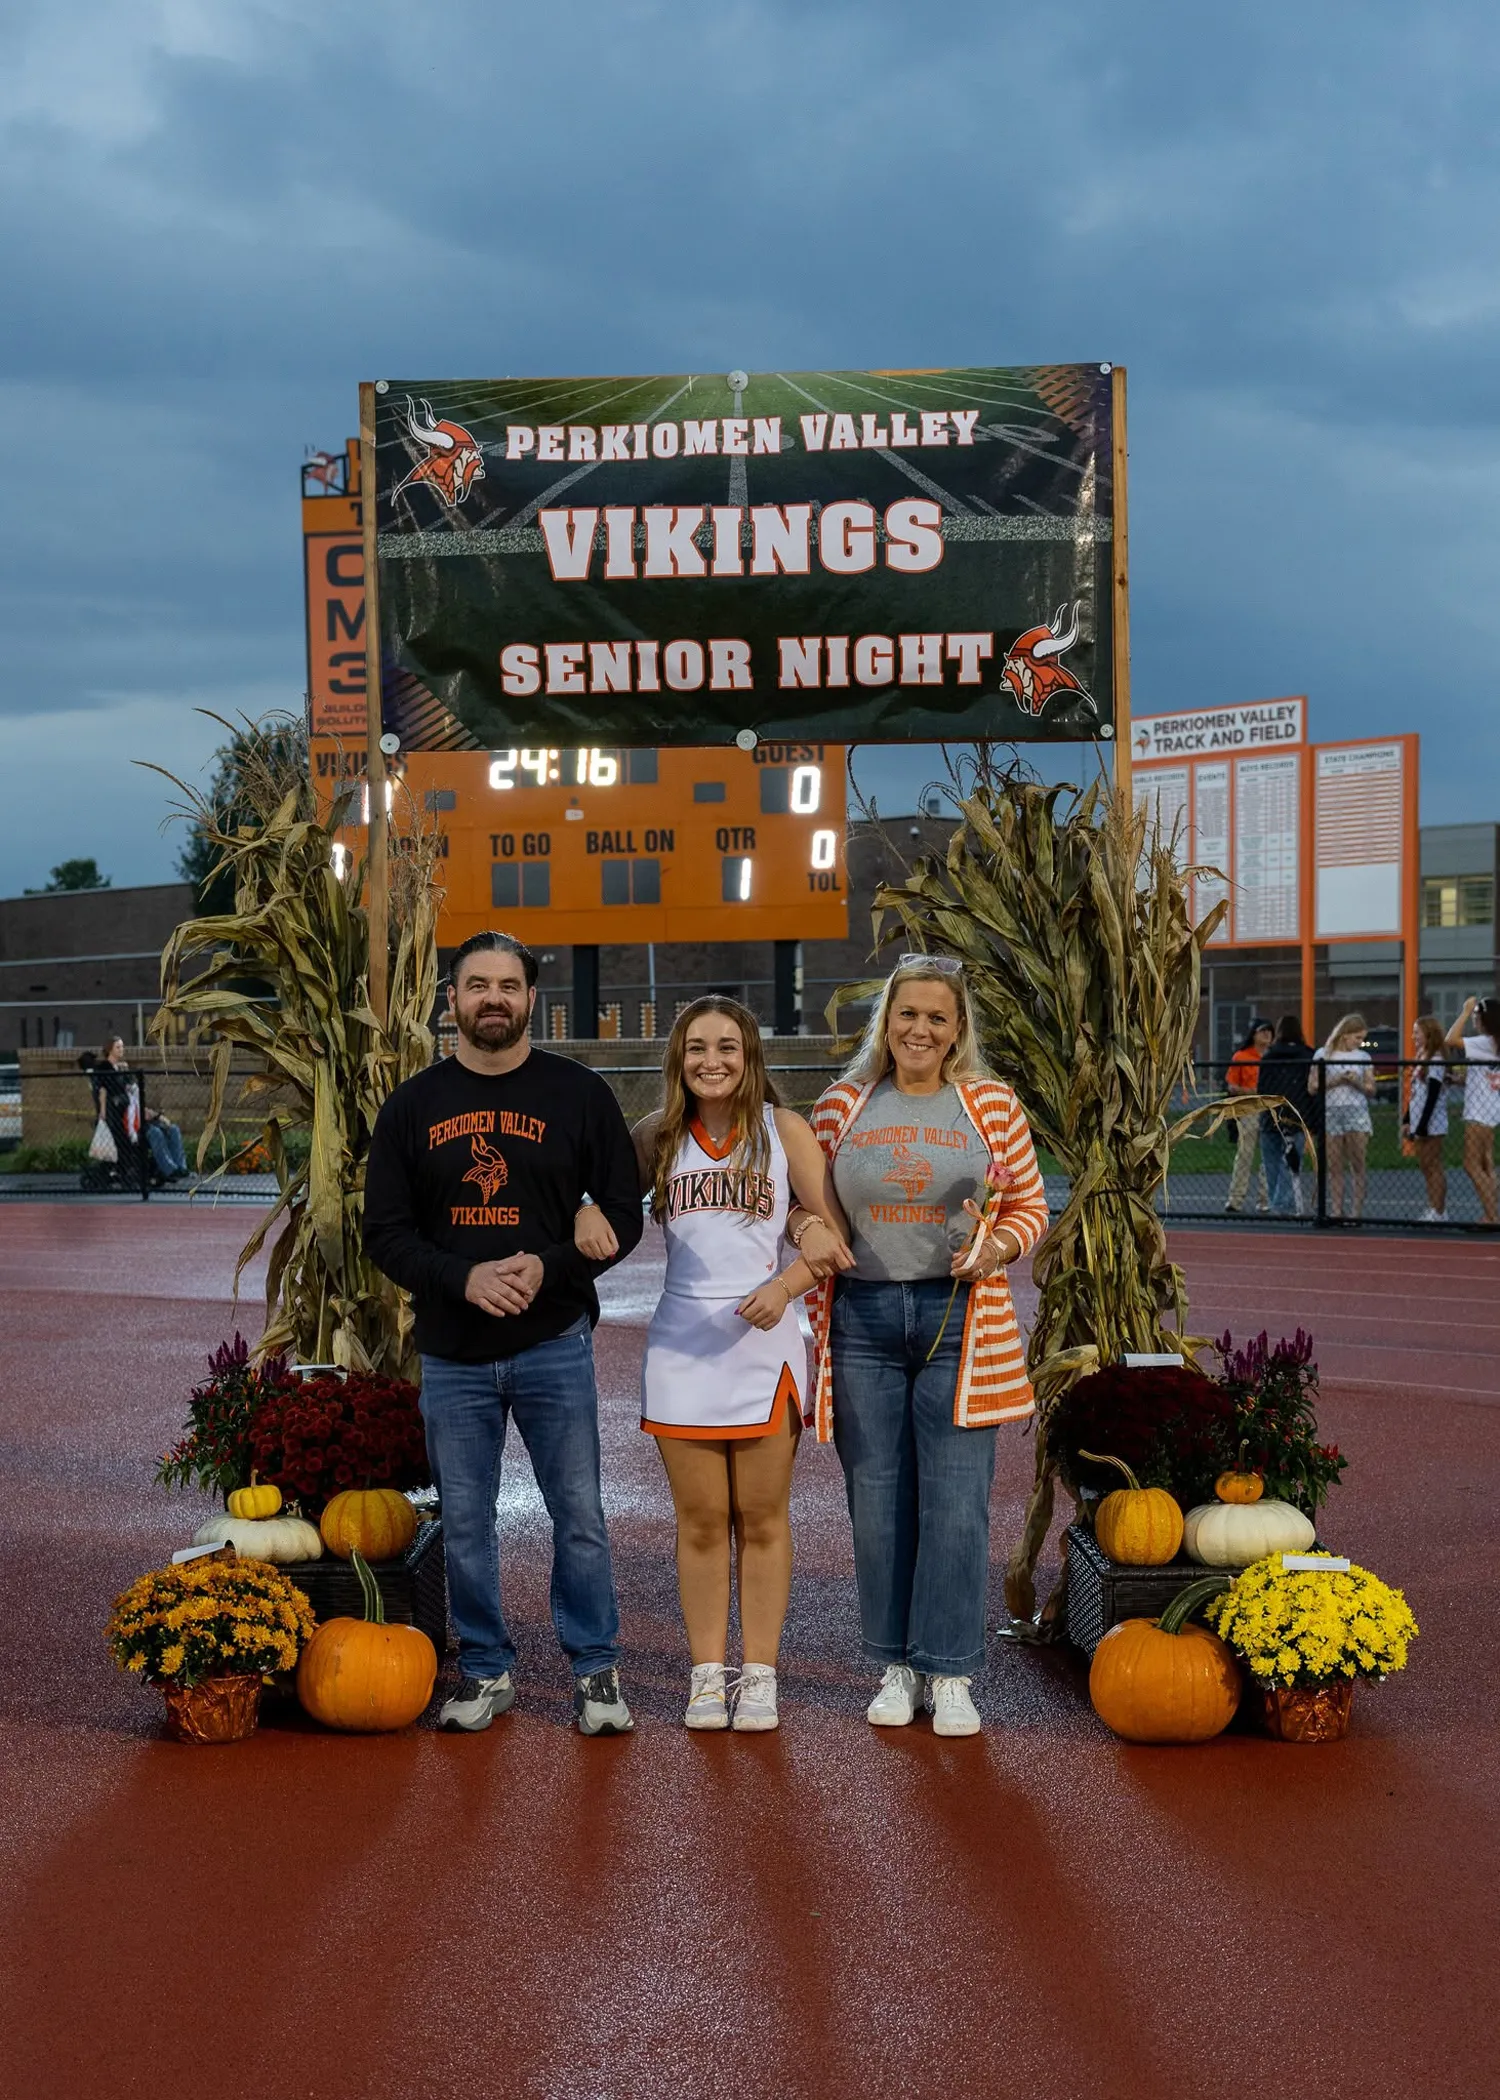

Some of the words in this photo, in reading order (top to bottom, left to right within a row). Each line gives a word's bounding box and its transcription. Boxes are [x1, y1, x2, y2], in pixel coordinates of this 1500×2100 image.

[505, 416, 783, 462] PERKIOMEN
[800, 409, 980, 452] VALLEY
[538, 498, 944, 582] VIKINGS
[500, 637, 754, 697] SENIOR
[777, 632, 994, 689] NIGHT
[1153, 713, 1236, 736] PERKIOMEN
[1240, 705, 1297, 725] VALLEY
[1154, 734, 1206, 753] TRACK
[1210, 728, 1245, 748] AND
[1250, 723, 1297, 742] FIELD
[489, 748, 618, 790] 24:16
[790, 765, 821, 814] 0
[489, 833, 515, 857] TO
[522, 832, 551, 856] GO
[586, 830, 638, 854] BALL
[645, 828, 674, 852] ON
[716, 826, 756, 853] QTR
[811, 830, 836, 869] 0
[807, 872, 841, 892] TOL
[428, 1110, 496, 1151] PERKIOMEN
[500, 1110, 546, 1144] VALLEY
[849, 1125, 919, 1152] PERKIOMEN
[923, 1126, 969, 1151] VALLEY
[450, 1206, 520, 1225] VIKINGS
[869, 1204, 946, 1224] VIKINGS
